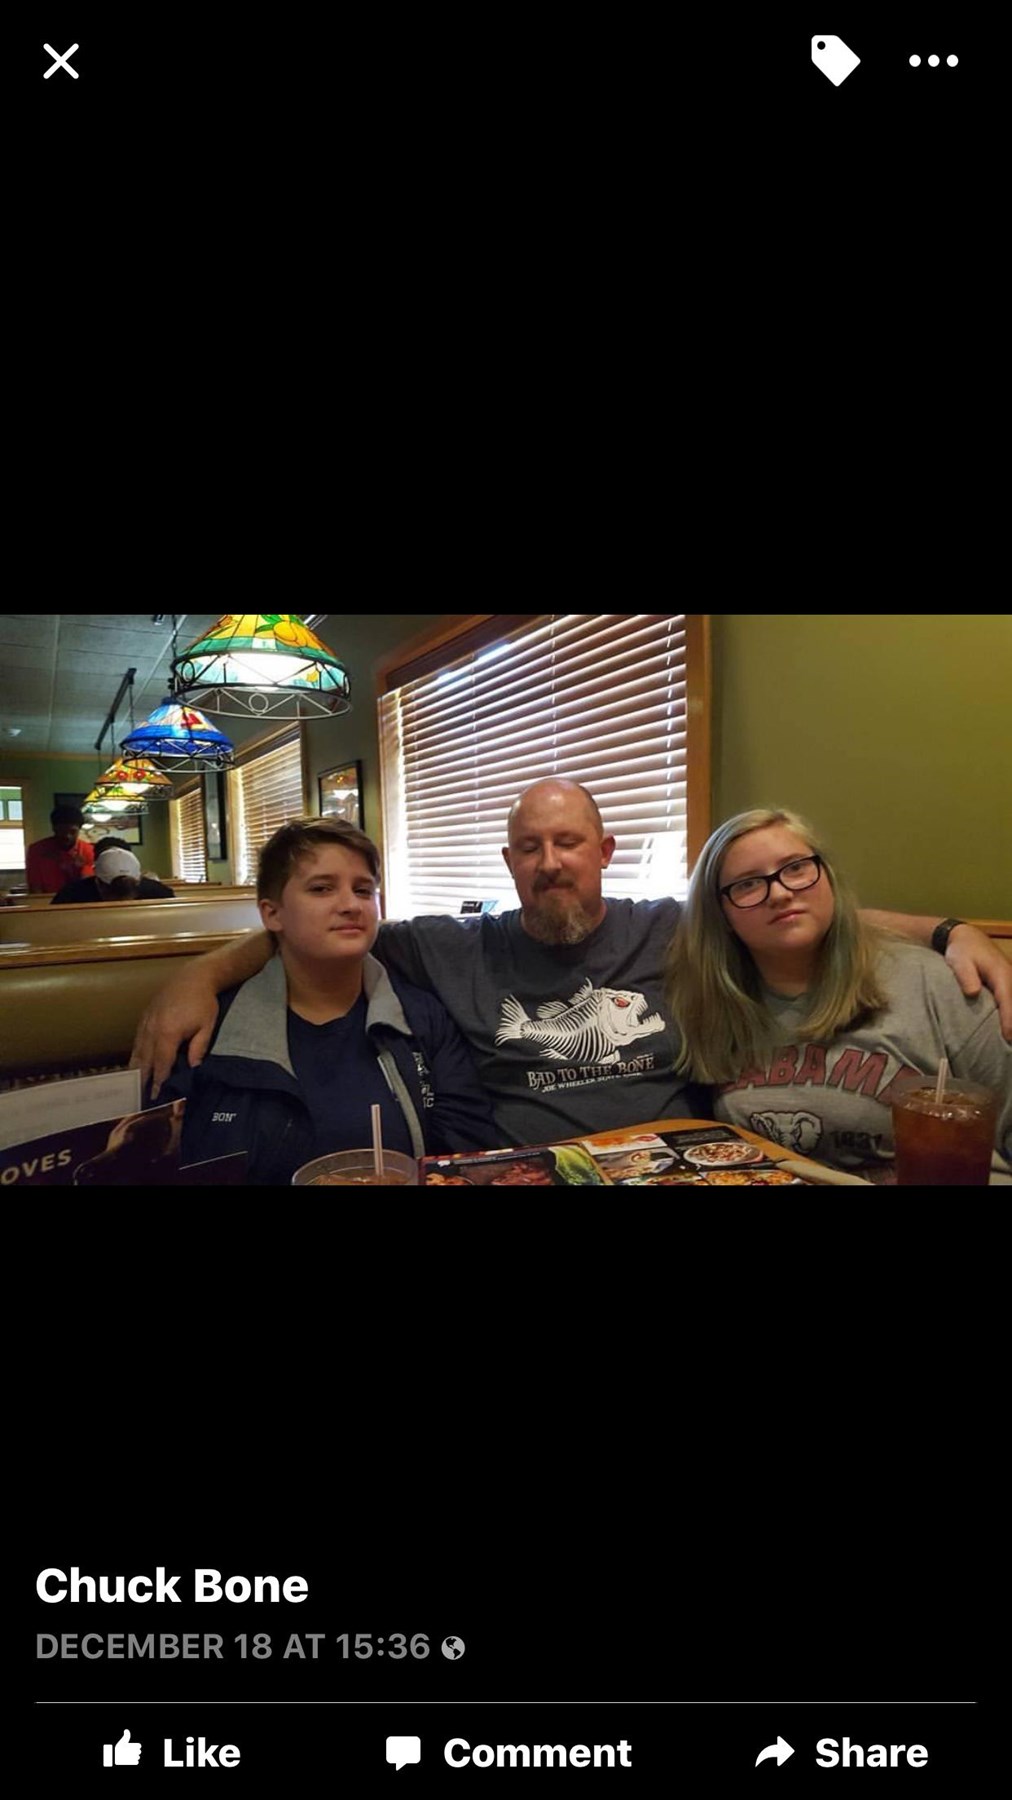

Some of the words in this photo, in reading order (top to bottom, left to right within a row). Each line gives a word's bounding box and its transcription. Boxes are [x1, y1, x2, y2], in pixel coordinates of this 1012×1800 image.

[526, 1071, 556, 1090] BAD
[557, 1068, 577, 1082] TO
[579, 1065, 612, 1078] THE
[616, 1056, 655, 1074] BONE
[0, 1149, 72, 1185] OVES
